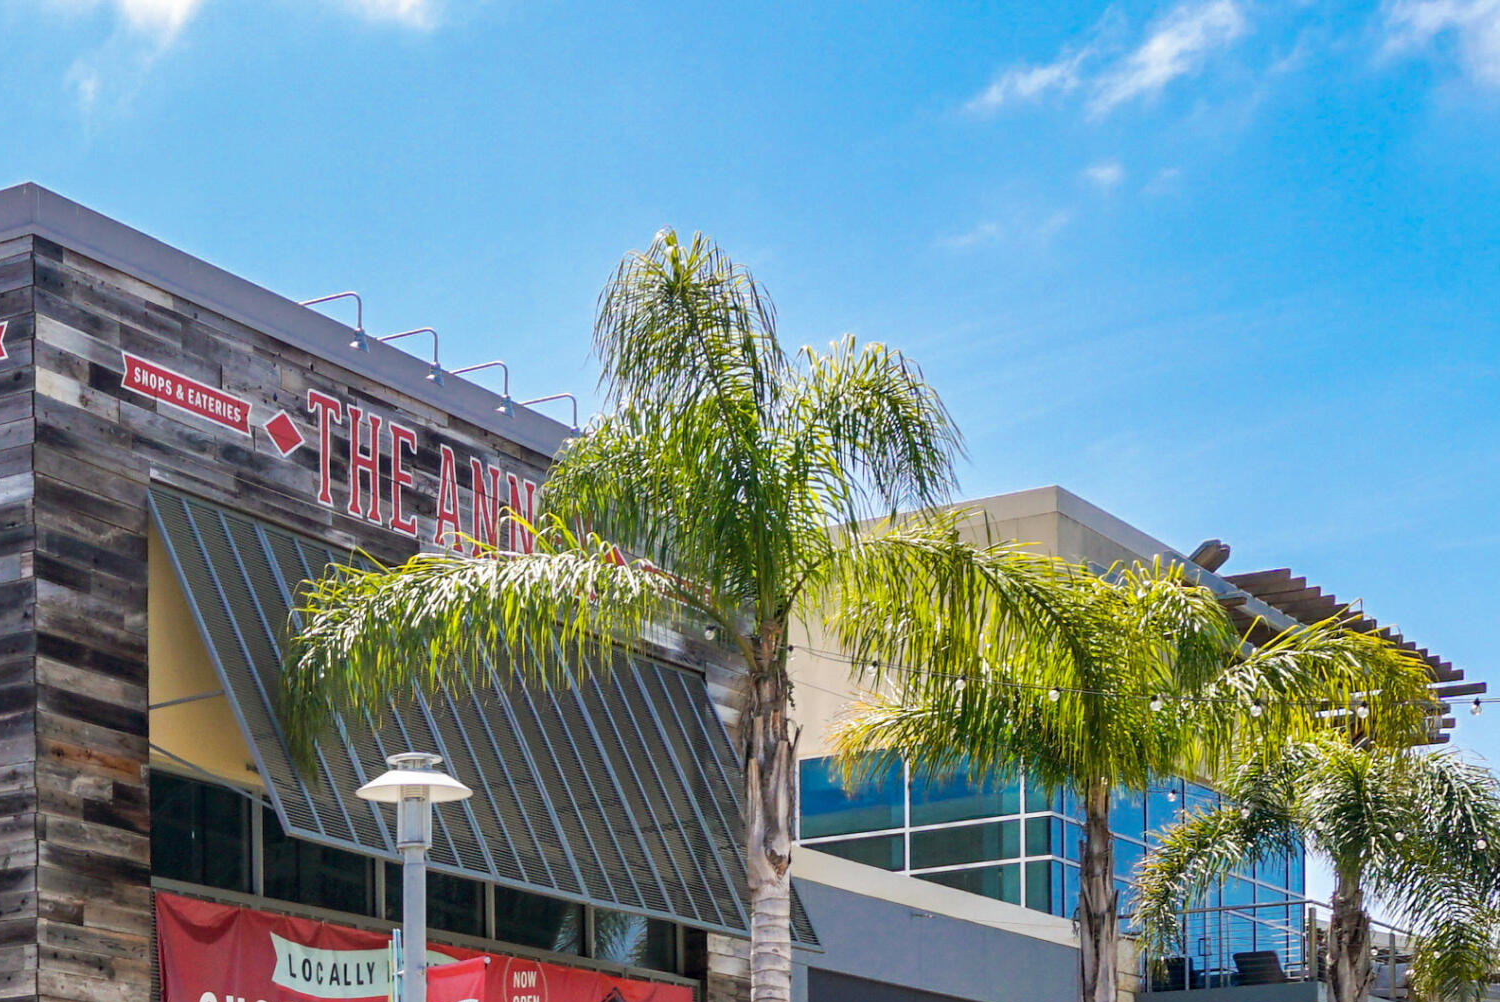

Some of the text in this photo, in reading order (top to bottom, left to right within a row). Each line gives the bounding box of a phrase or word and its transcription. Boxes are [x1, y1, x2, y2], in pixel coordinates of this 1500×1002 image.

[134, 367, 242, 423] SHOPS & EATERIES
[307, 389, 417, 538] THE
[288, 953, 376, 987] LOCALLY
[513, 971, 537, 988] NOW
